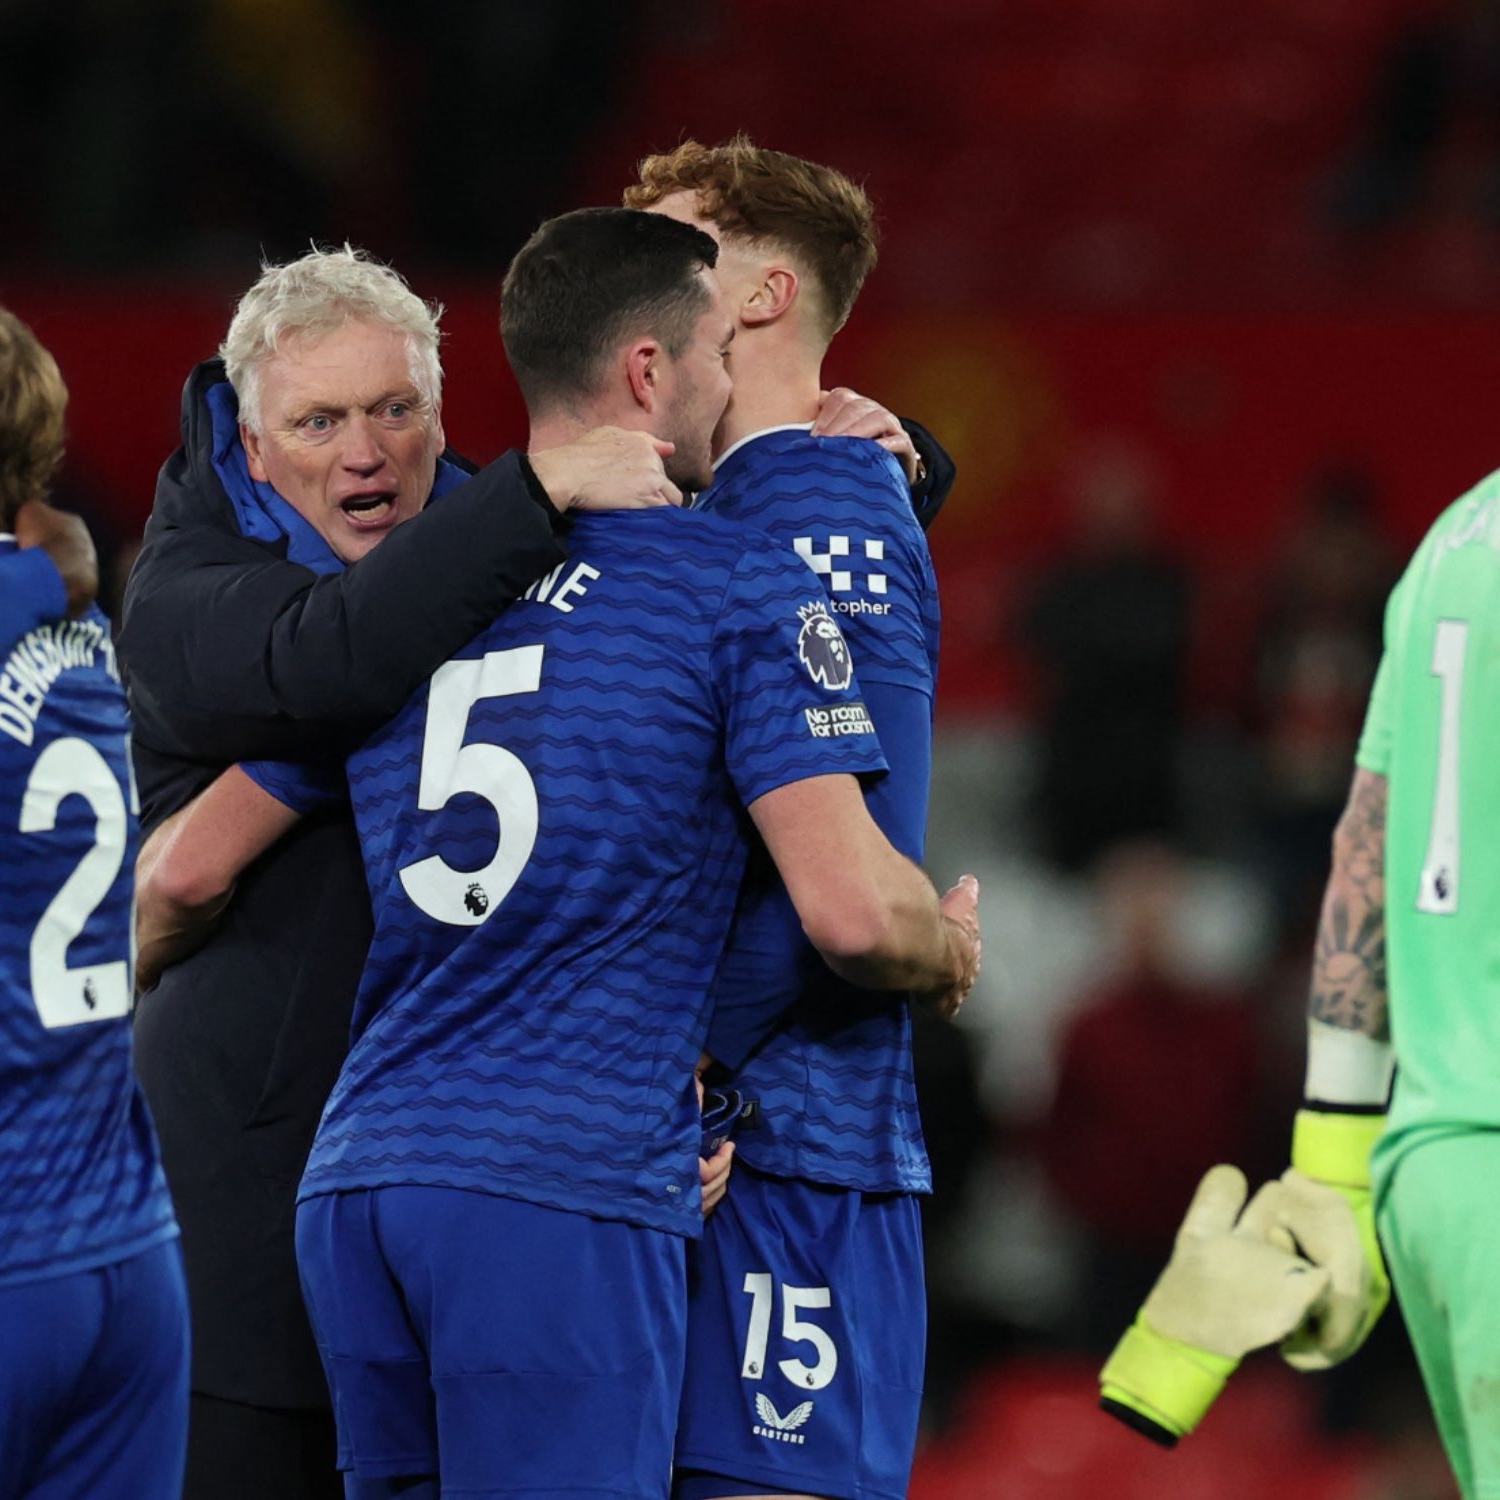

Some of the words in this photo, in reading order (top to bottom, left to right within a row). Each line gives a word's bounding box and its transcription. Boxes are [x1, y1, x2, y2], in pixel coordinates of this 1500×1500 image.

[830, 597, 892, 617] topher
[805, 708, 830, 724] No
[830, 706, 866, 722] room
[833, 720, 876, 737] racism
[1416, 617, 1470, 915] 1
[399, 644, 545, 926] 5
[741, 1272, 838, 1390] 15
[752, 1425, 805, 1445] CASTORE
